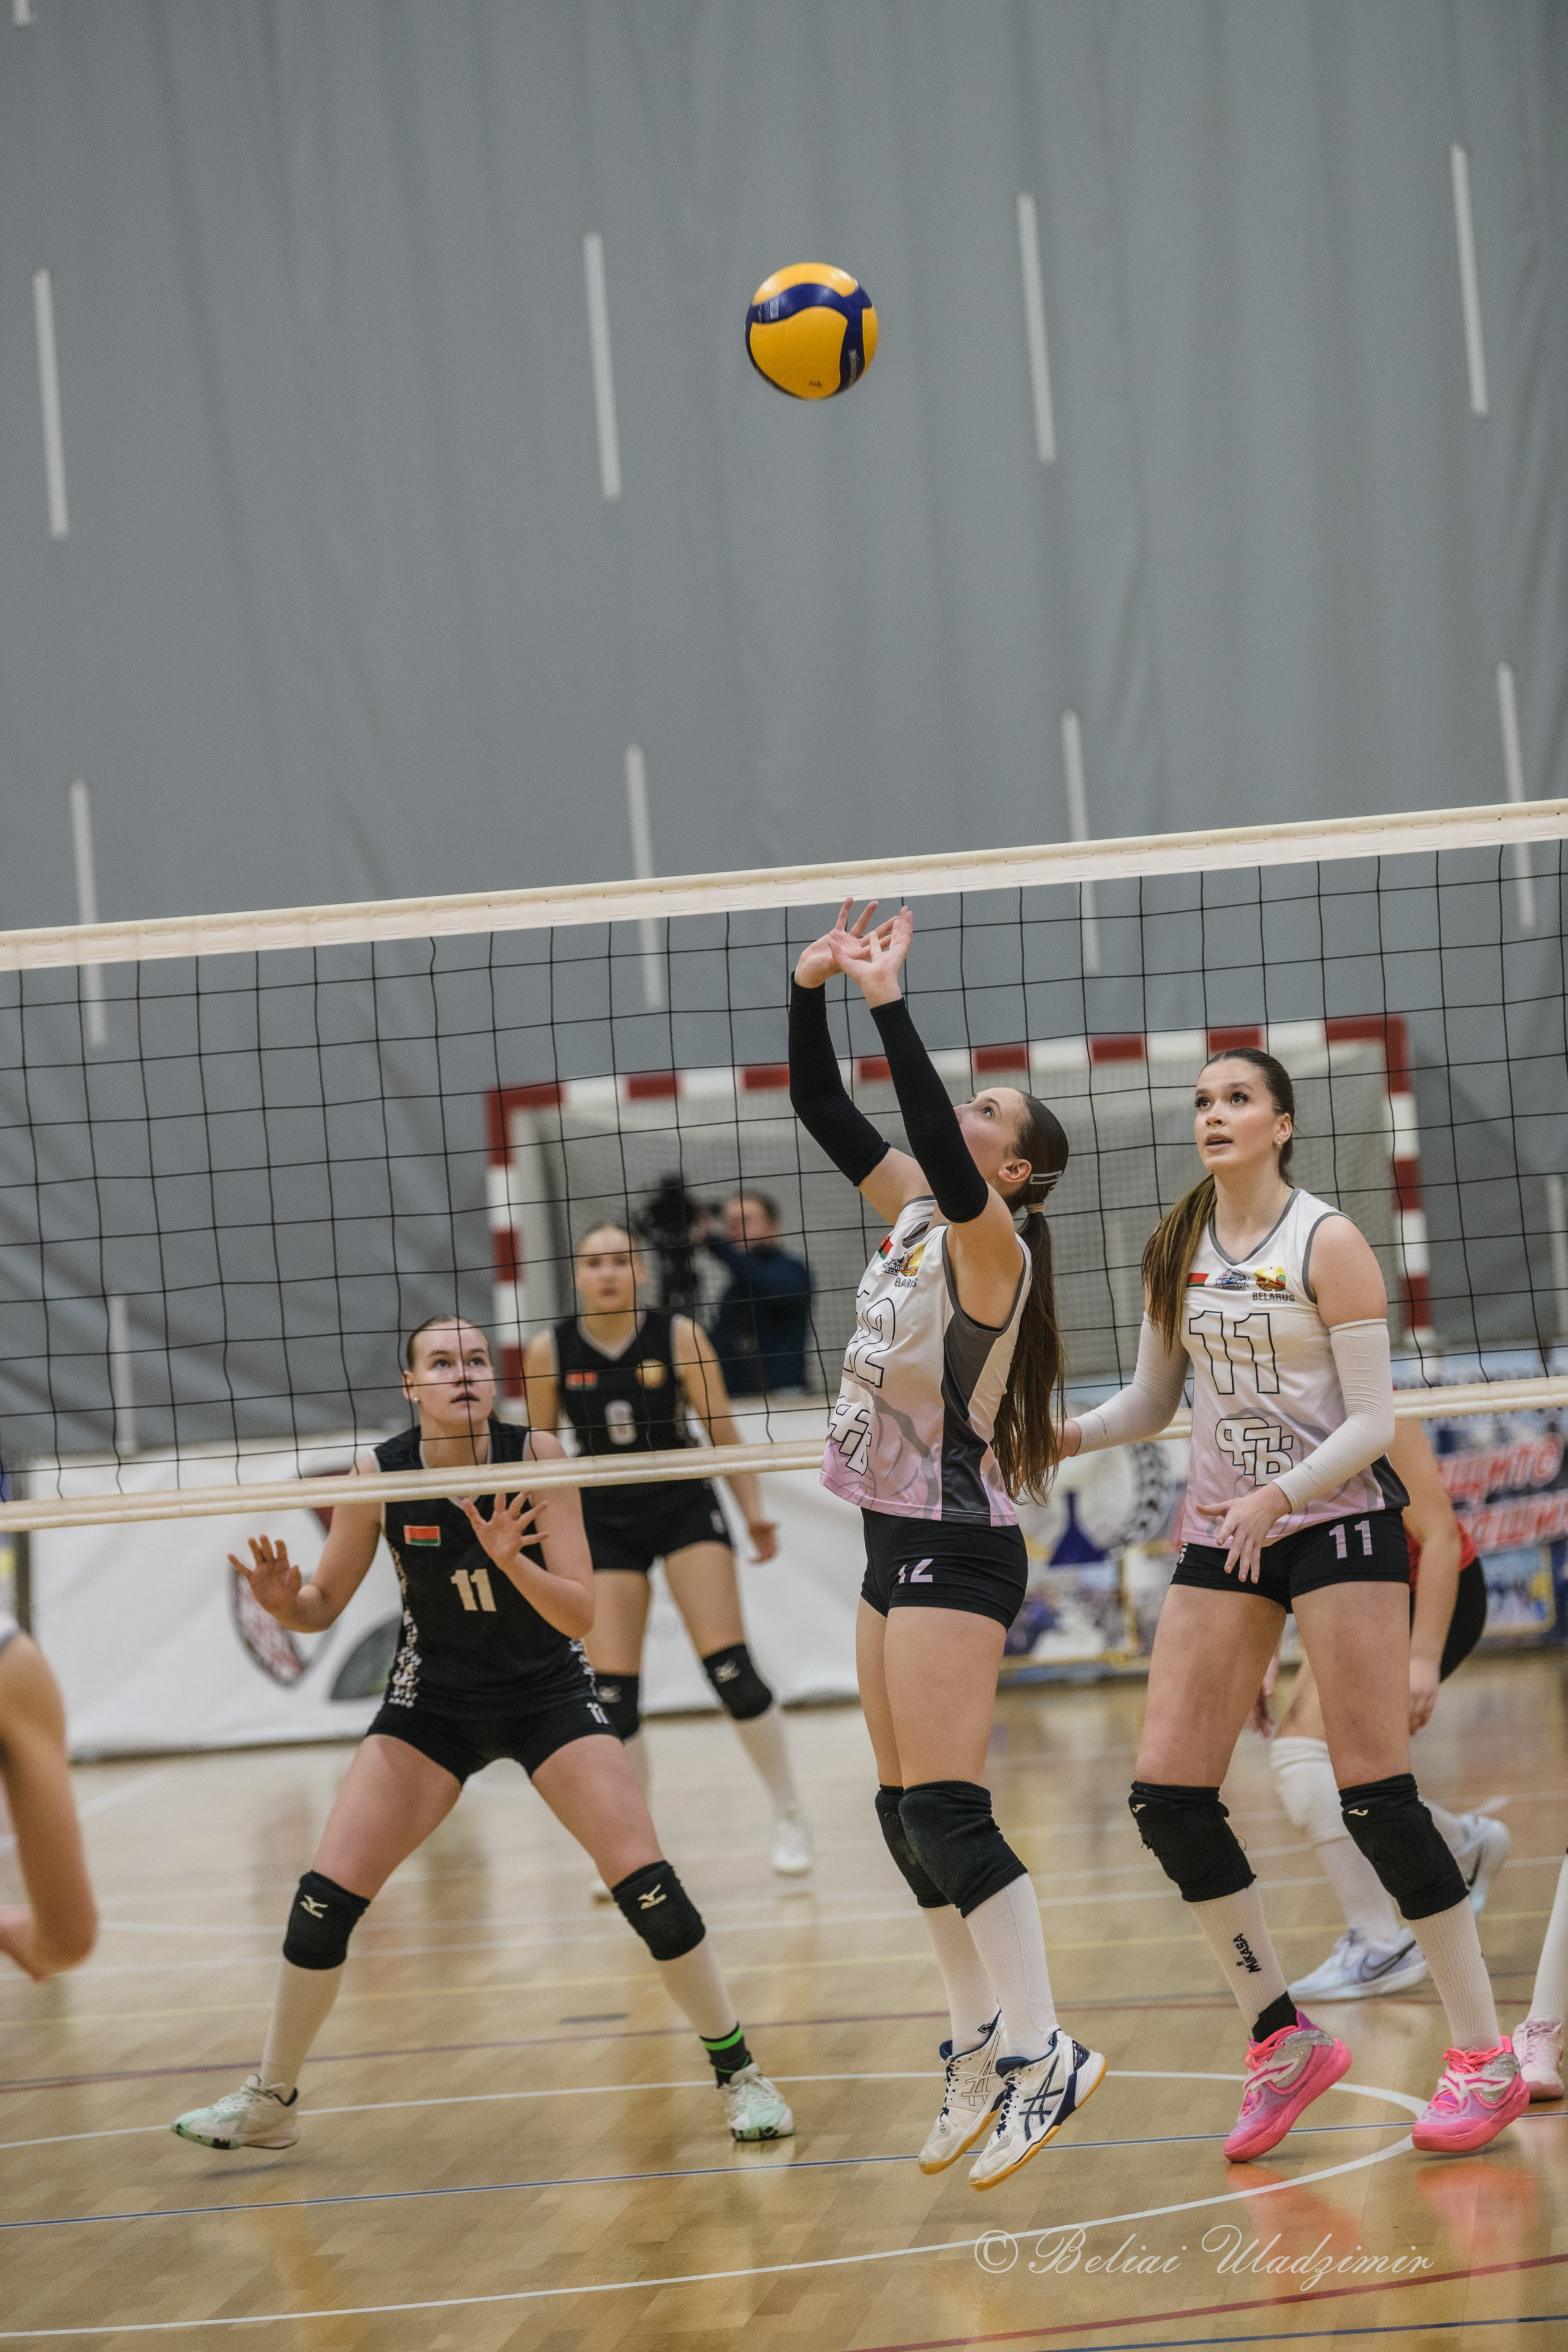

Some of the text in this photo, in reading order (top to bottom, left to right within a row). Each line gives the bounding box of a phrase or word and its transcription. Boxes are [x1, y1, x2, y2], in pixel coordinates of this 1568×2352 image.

[1253, 1292, 1295, 1302] BELARUS
[843, 1289, 895, 1389] 12
[1189, 1310, 1280, 1395] 11
[1329, 1520, 1373, 1559] 11
[450, 1568, 498, 1612] 11
[586, 1702, 609, 1725] 11
[1233, 1932, 1262, 1973] MIKASA
